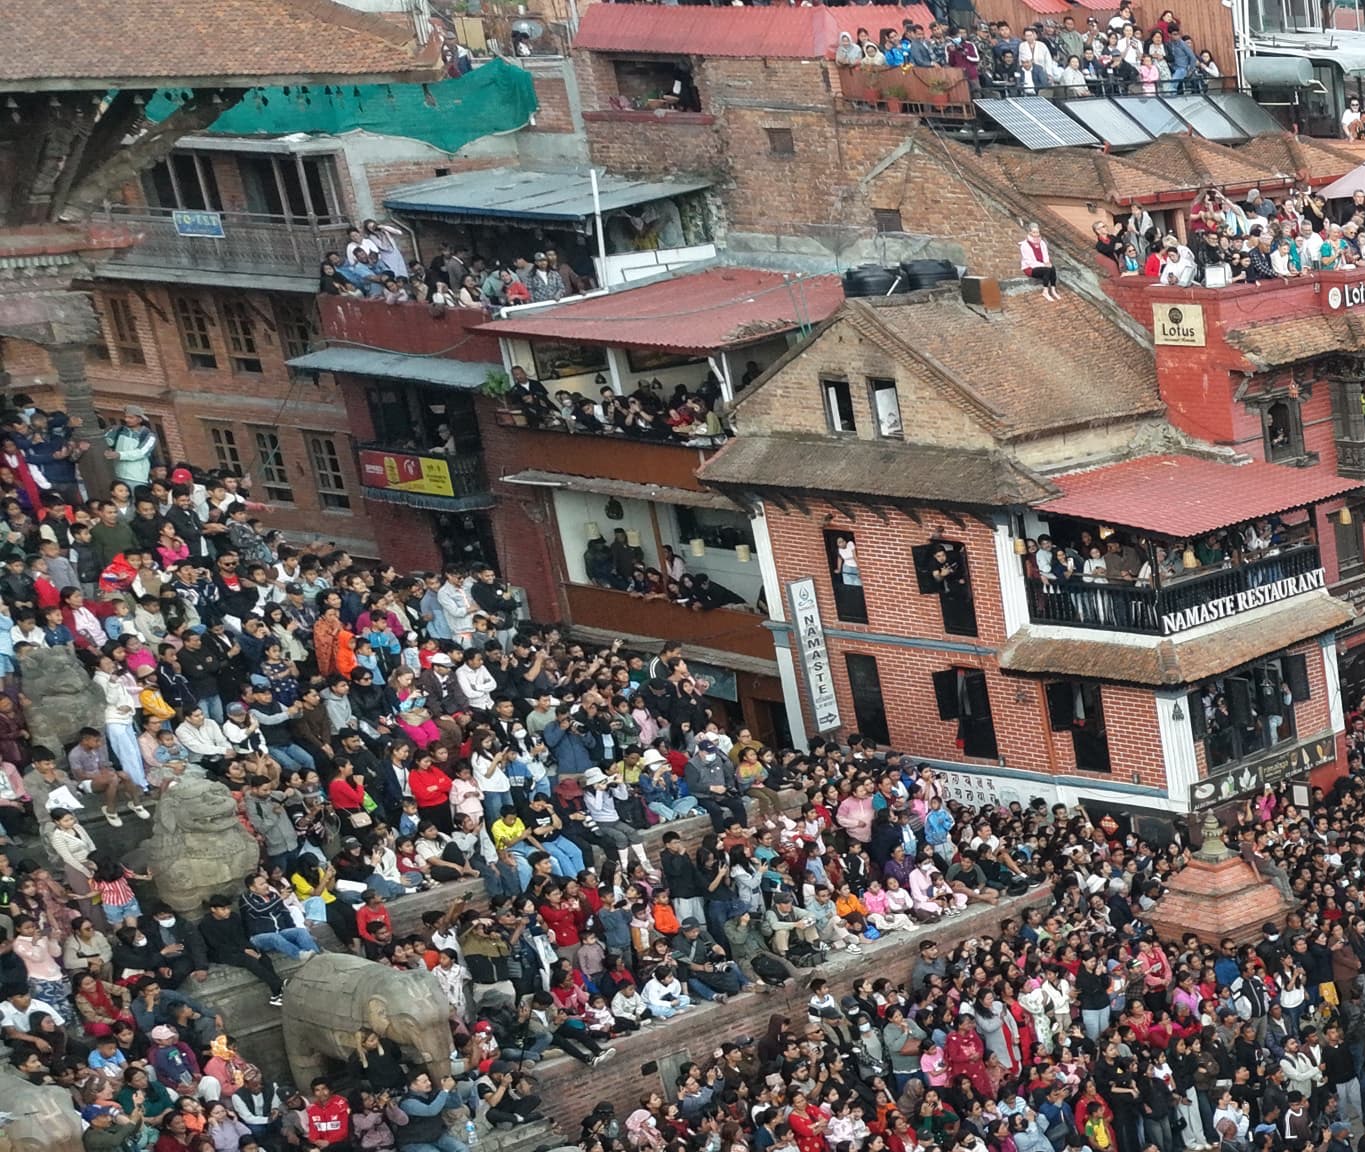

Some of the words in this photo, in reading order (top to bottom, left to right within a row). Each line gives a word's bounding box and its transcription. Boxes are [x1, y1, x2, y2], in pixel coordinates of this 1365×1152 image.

[1162, 323, 1195, 337] Lotus
[1161, 594, 1236, 635] NAMASTE
[1236, 567, 1326, 613] RESTAURANT
[804, 614, 828, 695] NAMASTE
